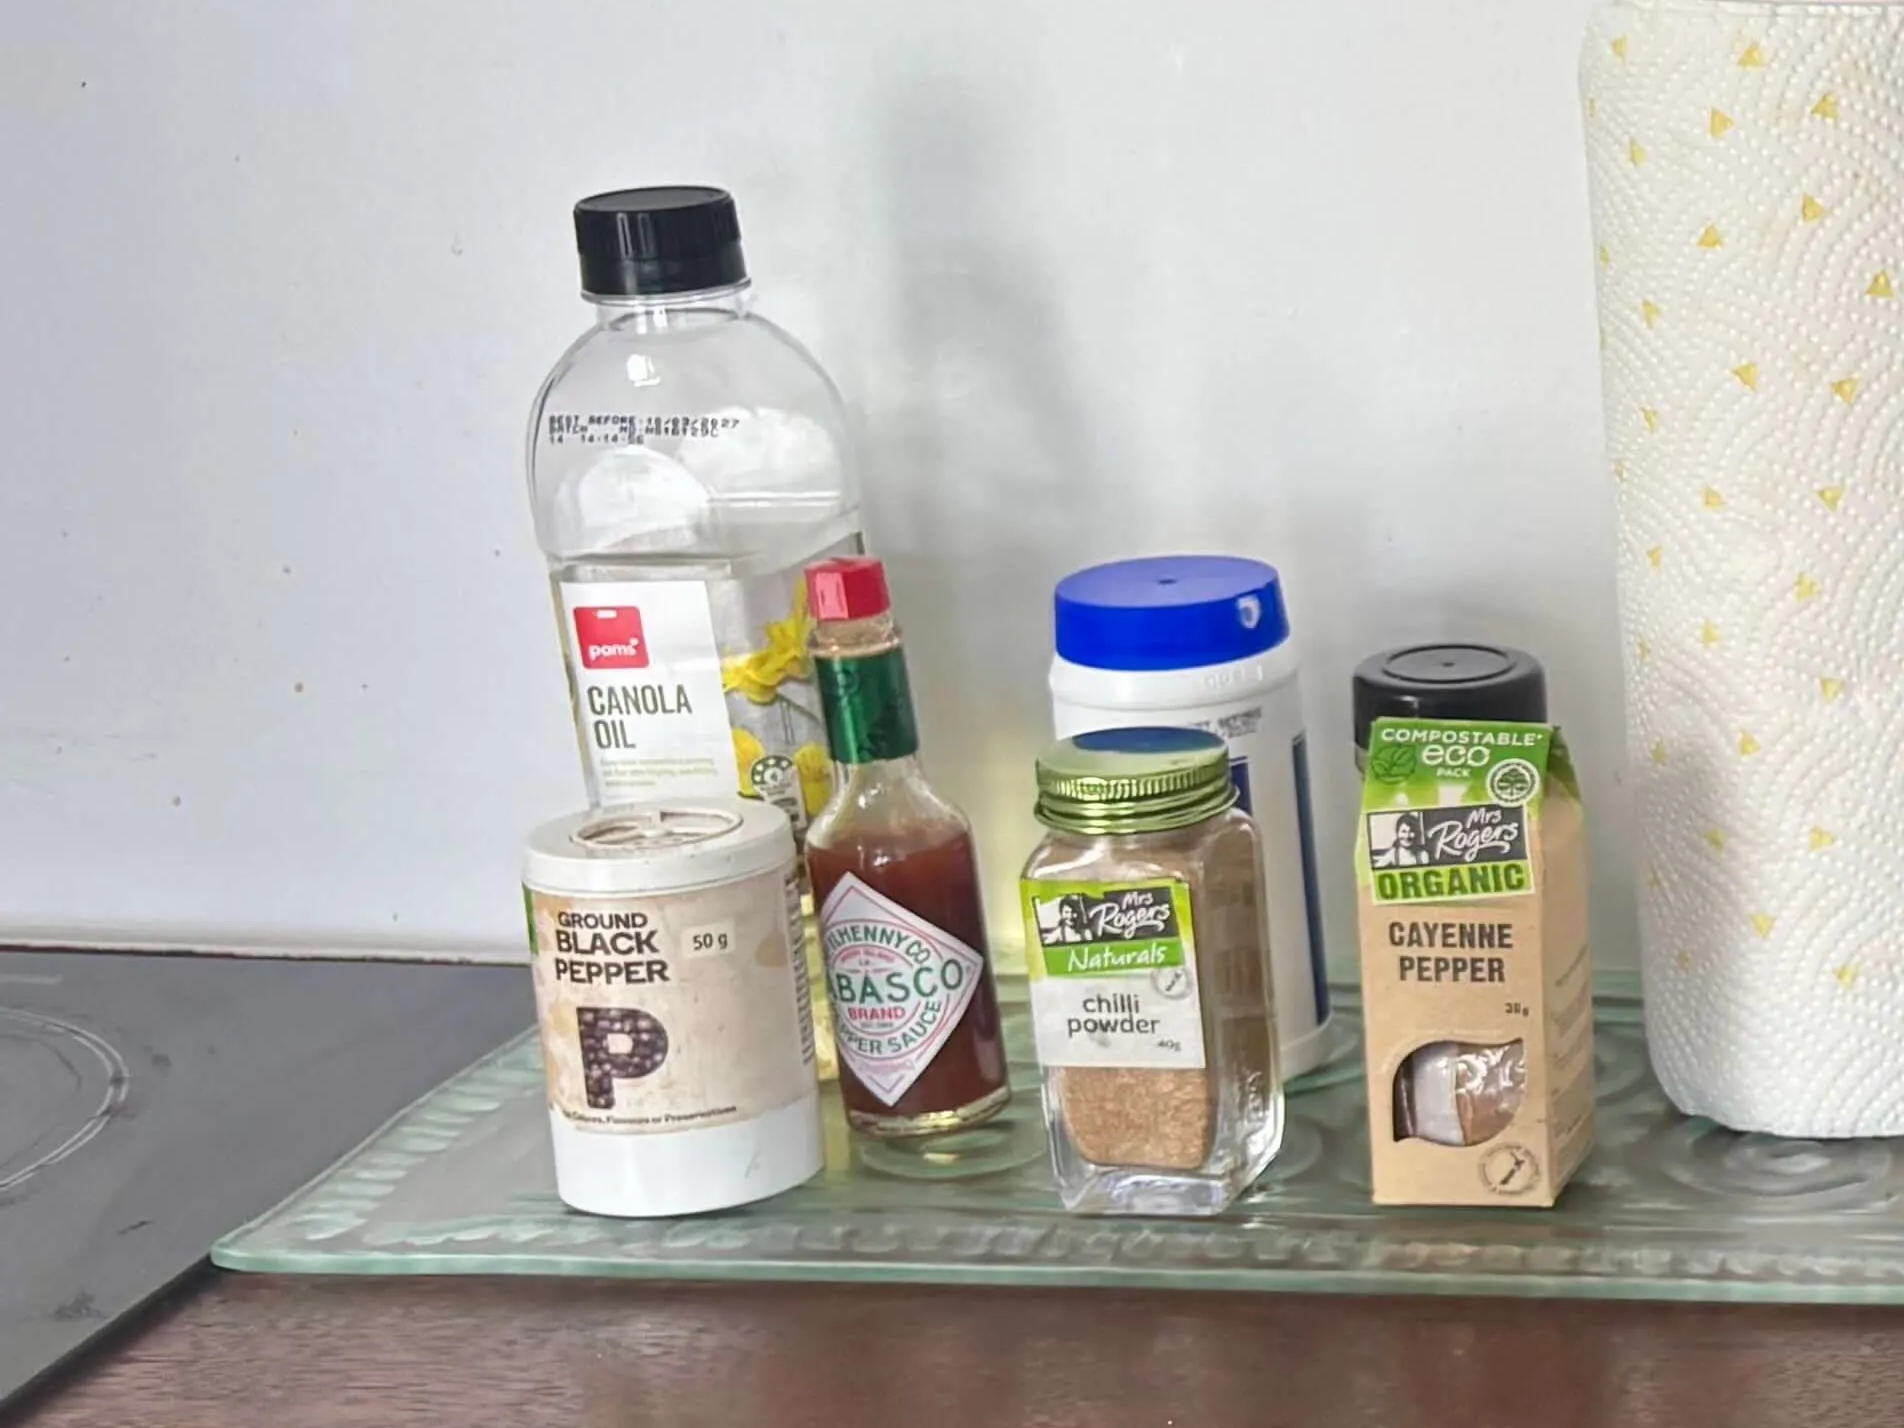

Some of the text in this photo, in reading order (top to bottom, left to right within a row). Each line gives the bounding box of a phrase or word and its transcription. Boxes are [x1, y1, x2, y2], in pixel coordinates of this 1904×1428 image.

[588, 641, 638, 661] pams
[587, 684, 692, 716] CANOLA
[594, 719, 636, 750] OIL
[1422, 744, 1490, 767] eco
[1436, 768, 1471, 778] PACK
[1466, 807, 1502, 829] Mrs
[1427, 820, 1519, 862] Rogers
[1378, 863, 1525, 900] ORGANIC
[1122, 892, 1153, 910] Mrs
[558, 912, 648, 930] GROUND
[1089, 903, 1171, 939] Rogers
[556, 929, 660, 956] BLACK
[693, 933, 728, 950] 50 g
[1389, 921, 1513, 949] CAYENNE
[1068, 942, 1168, 972] Naturals
[1399, 956, 1506, 983] PEPPER
[555, 958, 671, 985] PEPPER
[848, 1006, 905, 1020] BRAND
[1082, 994, 1140, 1013] chilli
[887, 999, 942, 1053] SAUCE
[1067, 1015, 1160, 1038] powder
